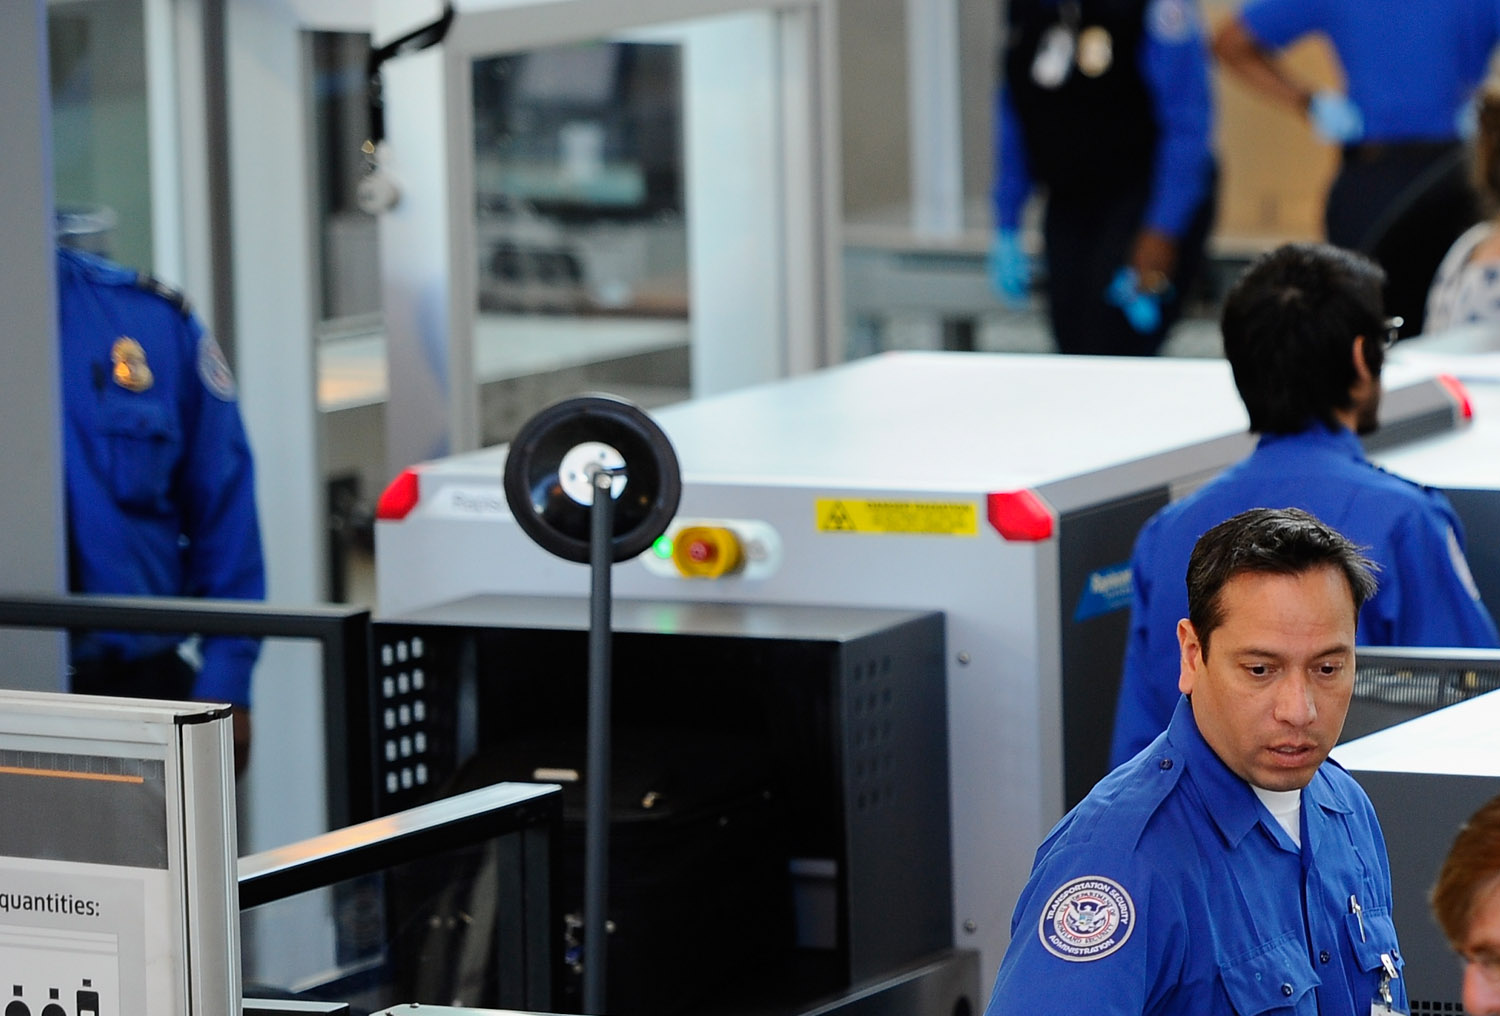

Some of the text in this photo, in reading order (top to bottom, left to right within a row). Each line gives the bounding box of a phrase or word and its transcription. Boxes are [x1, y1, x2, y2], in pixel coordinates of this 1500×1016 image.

[0, 893, 100, 917] quantities:
[1046, 881, 1129, 925] TRANSPORTATION SECURITY
[1048, 934, 1115, 955] ADMINISTRATION
